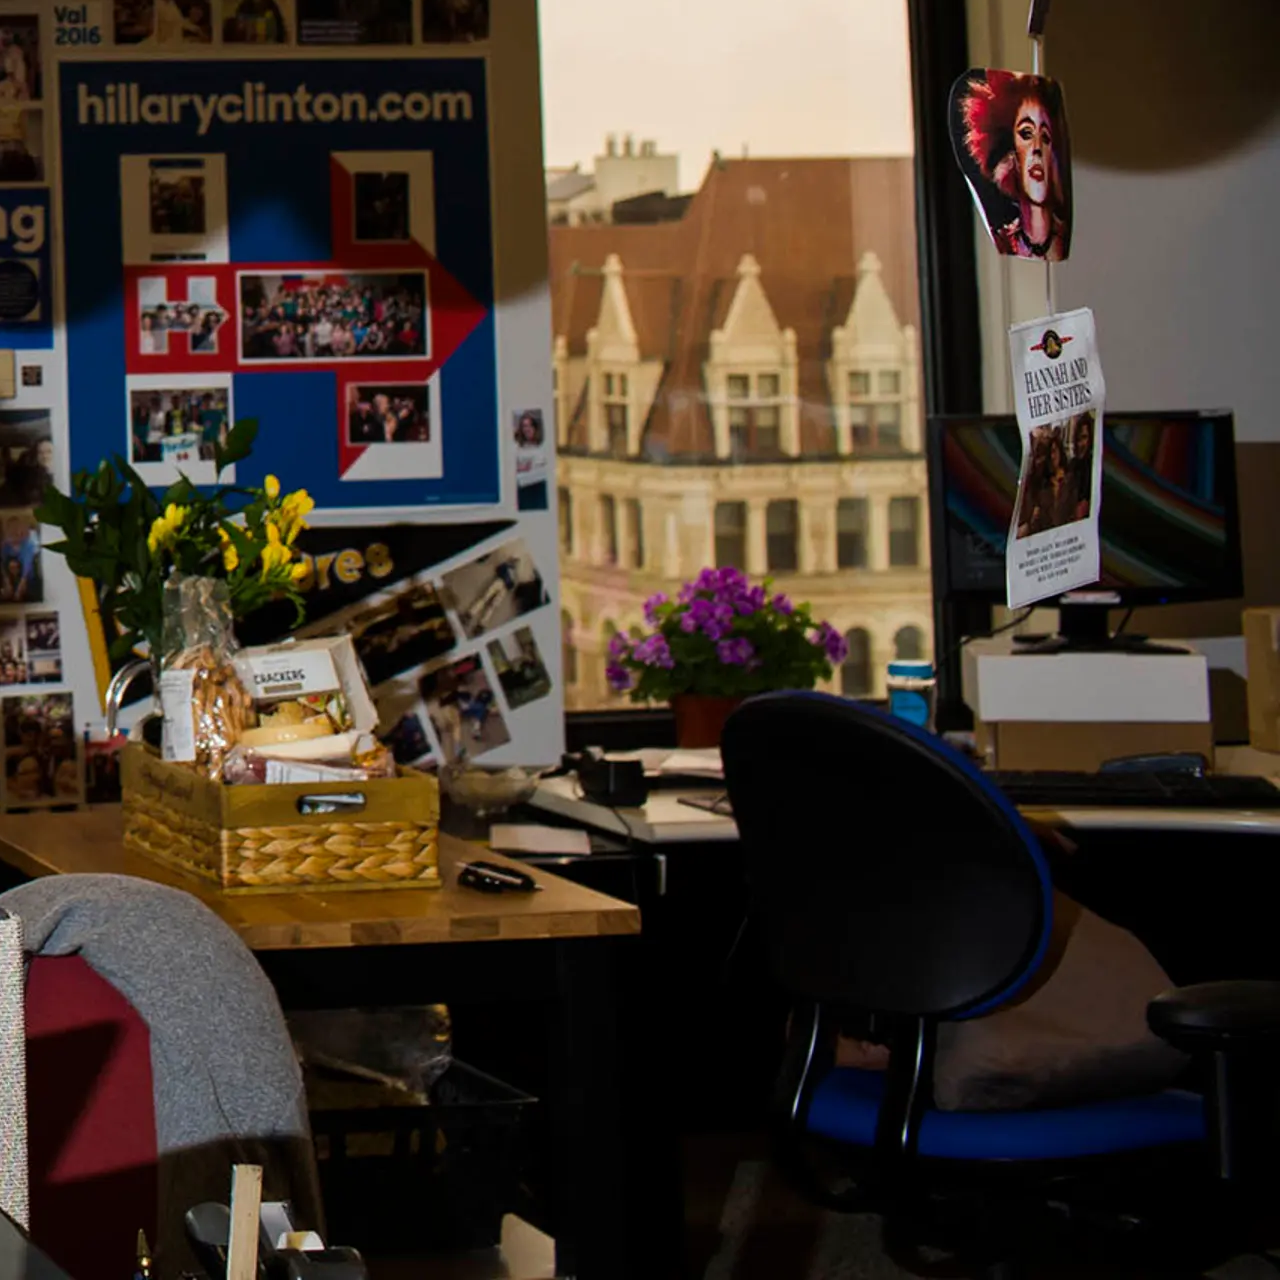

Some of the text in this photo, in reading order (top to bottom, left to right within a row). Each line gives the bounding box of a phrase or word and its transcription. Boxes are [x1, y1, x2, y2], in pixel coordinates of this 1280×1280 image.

[54, 5, 87, 24] Val
[54, 26, 102, 46] 2016
[77, 82, 473, 136] hillaryclinton.com
[1024, 357, 1089, 394] HANNAH AND
[1028, 381, 1093, 418] HER SISTERS
[253, 668, 307, 685] CRACKERS
